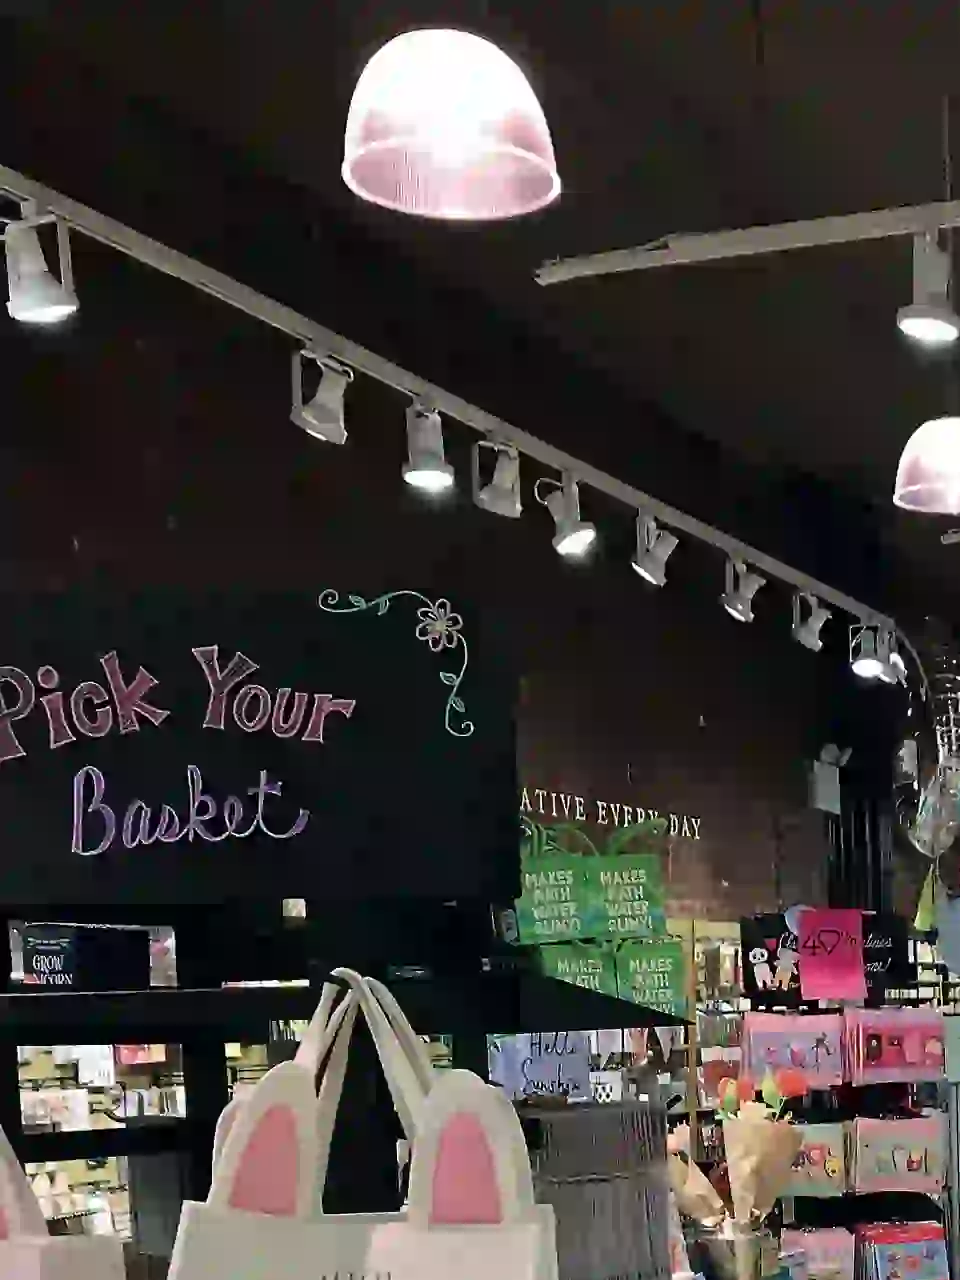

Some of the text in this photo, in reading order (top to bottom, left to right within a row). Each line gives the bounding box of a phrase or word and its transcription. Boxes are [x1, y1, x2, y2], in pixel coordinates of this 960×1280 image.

[0, 644, 356, 761] Pick Your
[72, 765, 310, 856] Basket
[520, 787, 586, 821] ATIVE
[669, 814, 701, 840] DAY
[32, 954, 65, 972] GROW
[36, 973, 73, 985] NICORN
